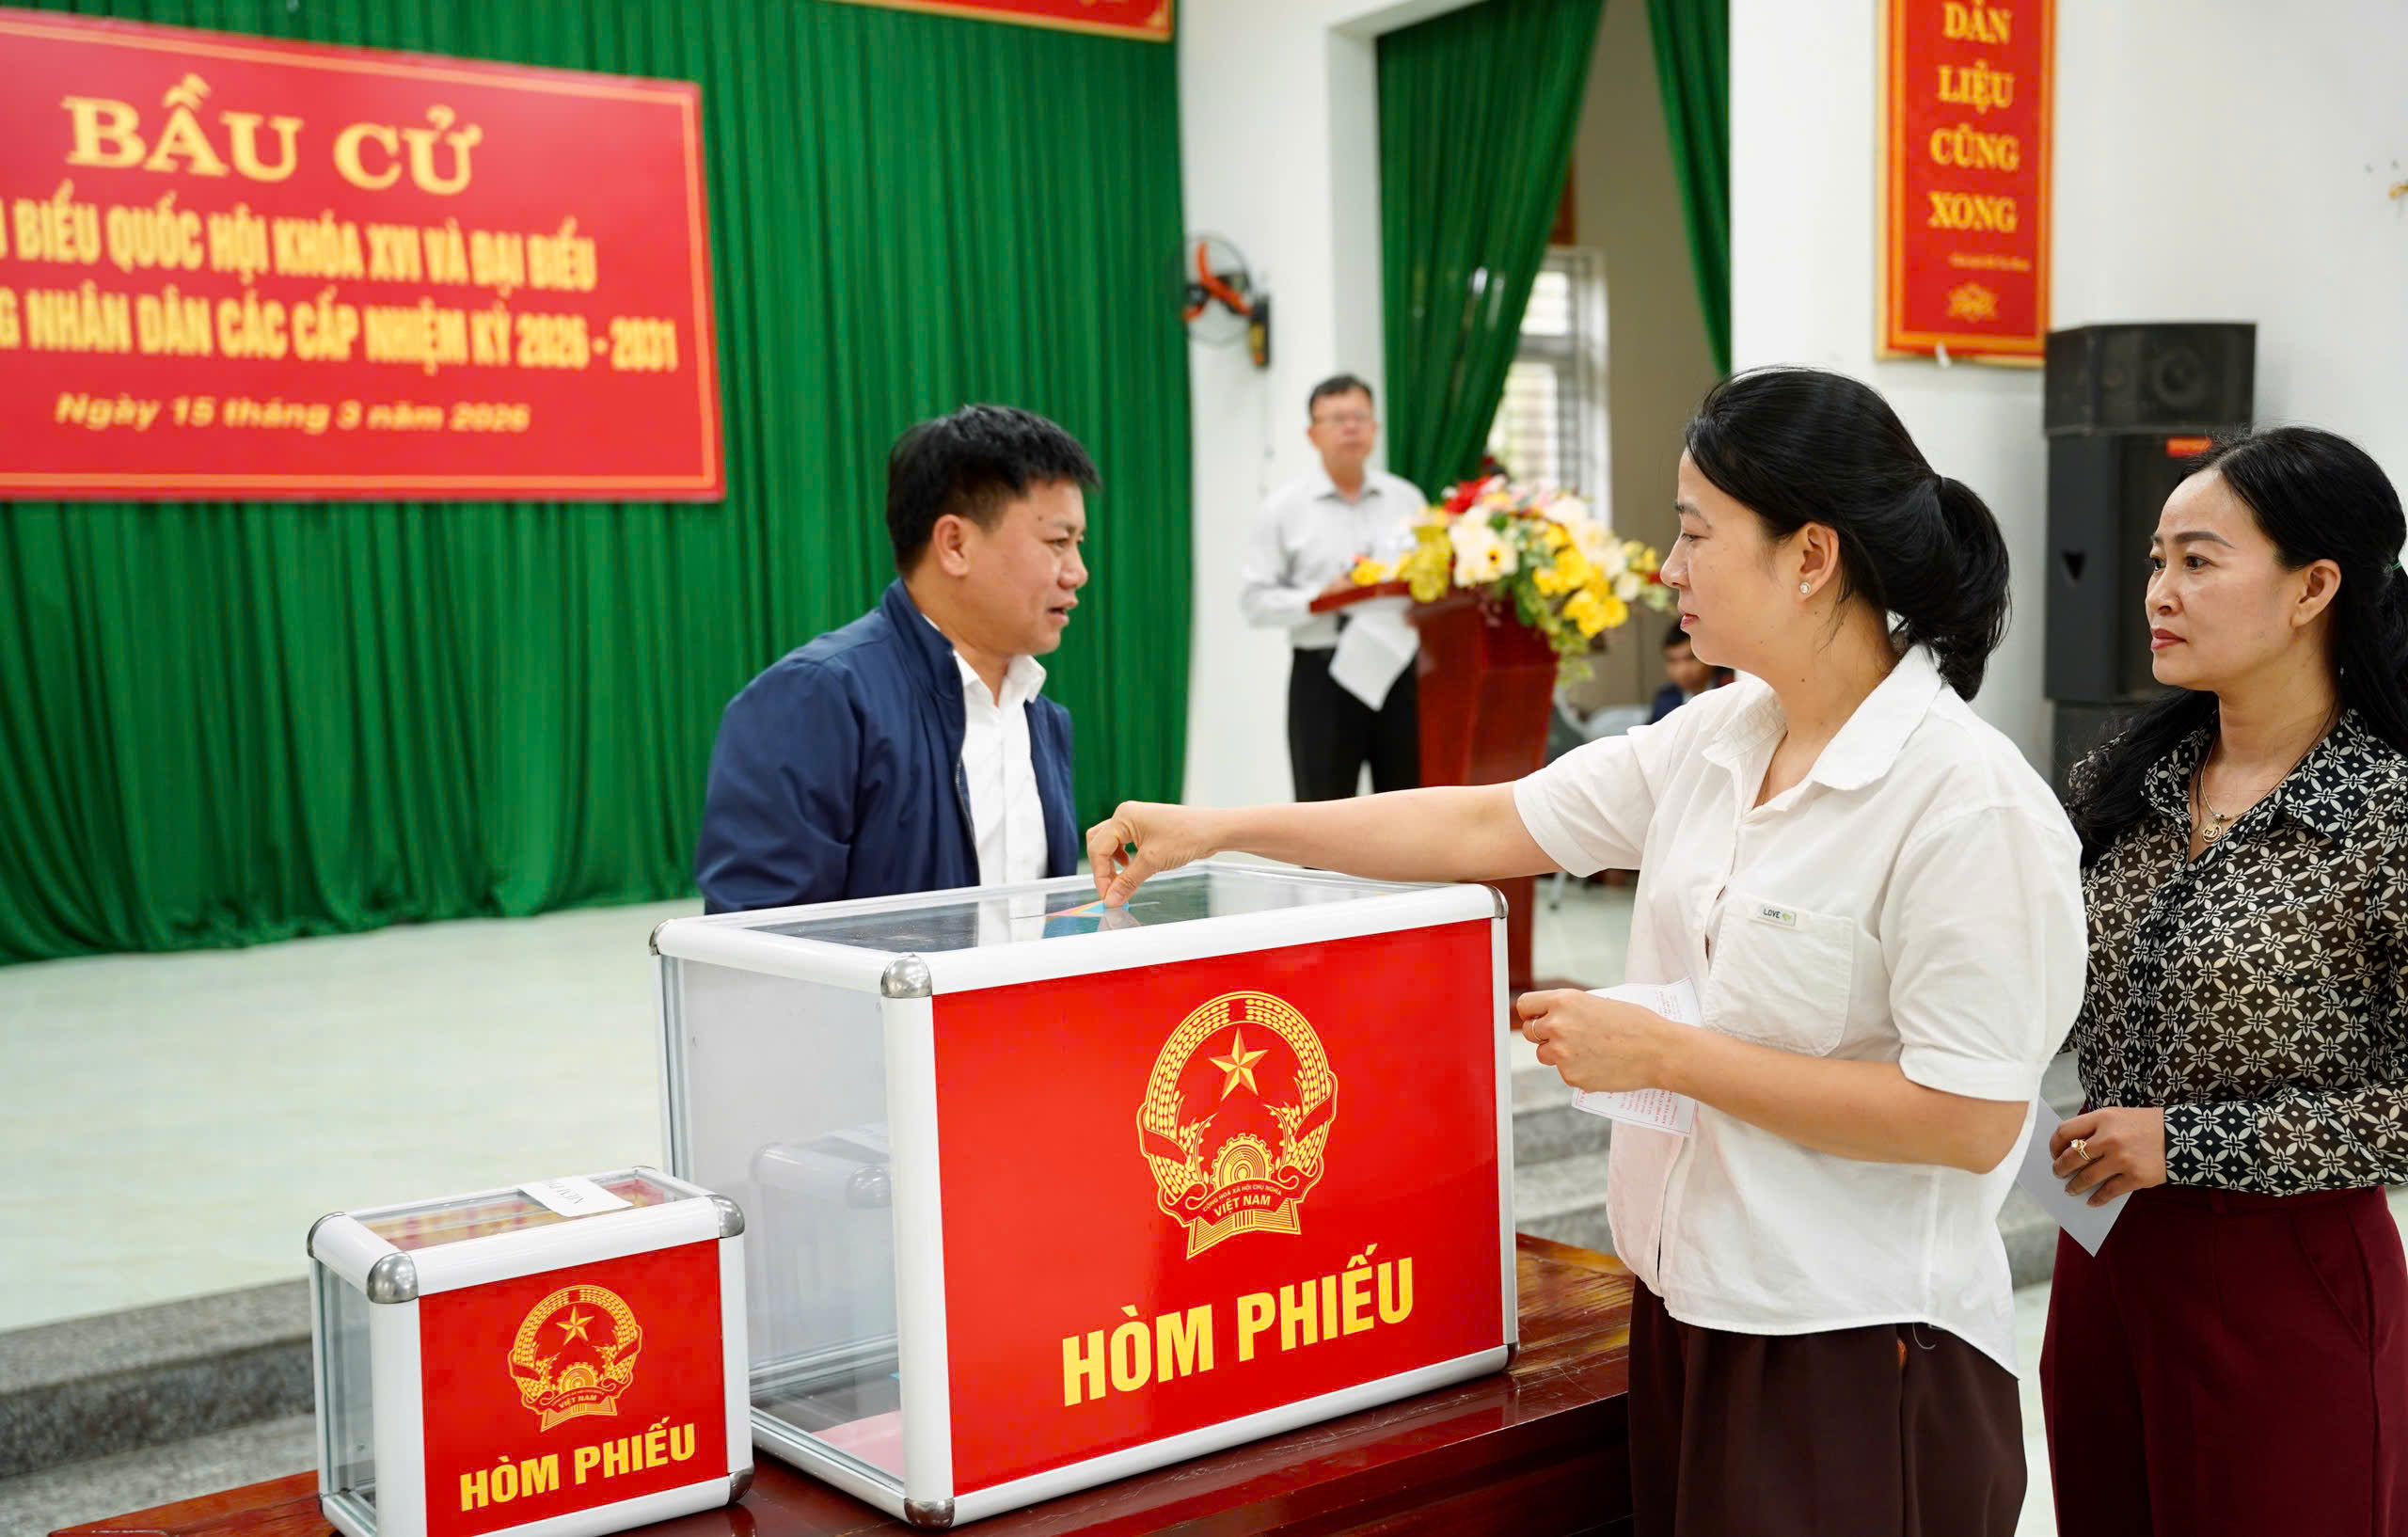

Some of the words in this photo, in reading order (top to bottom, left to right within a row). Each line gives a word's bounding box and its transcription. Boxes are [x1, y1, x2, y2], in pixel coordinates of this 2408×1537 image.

[1938, 58, 2015, 115] LIỆU
[61, 72, 304, 182] BẦU
[333, 103, 484, 195] CỬ
[105, 188, 205, 275] QUỐC
[207, 200, 270, 287] HỘI
[1928, 190, 2018, 233] XONG
[25, 278, 133, 355] NHÂN
[135, 282, 214, 358] DÂN
[216, 287, 291, 361] CÁC
[291, 284, 360, 362] CẤP
[54, 392, 161, 432] Ngày
[171, 395, 216, 428] 15
[222, 395, 332, 436] tháng
[335, 399, 362, 431] 3
[367, 400, 445, 432] năm
[1763, 908, 1781, 919] LOVE
[1213, 1196, 1240, 1216] VIỆT
[1243, 1194, 1271, 1207] NAM
[1062, 1304, 1214, 1407] HÒM
[1237, 1243, 1414, 1363] PHIẾU
[578, 1394, 597, 1403] NAM
[459, 1454, 560, 1513] HÒM
[574, 1416, 696, 1485] PHIẾU
